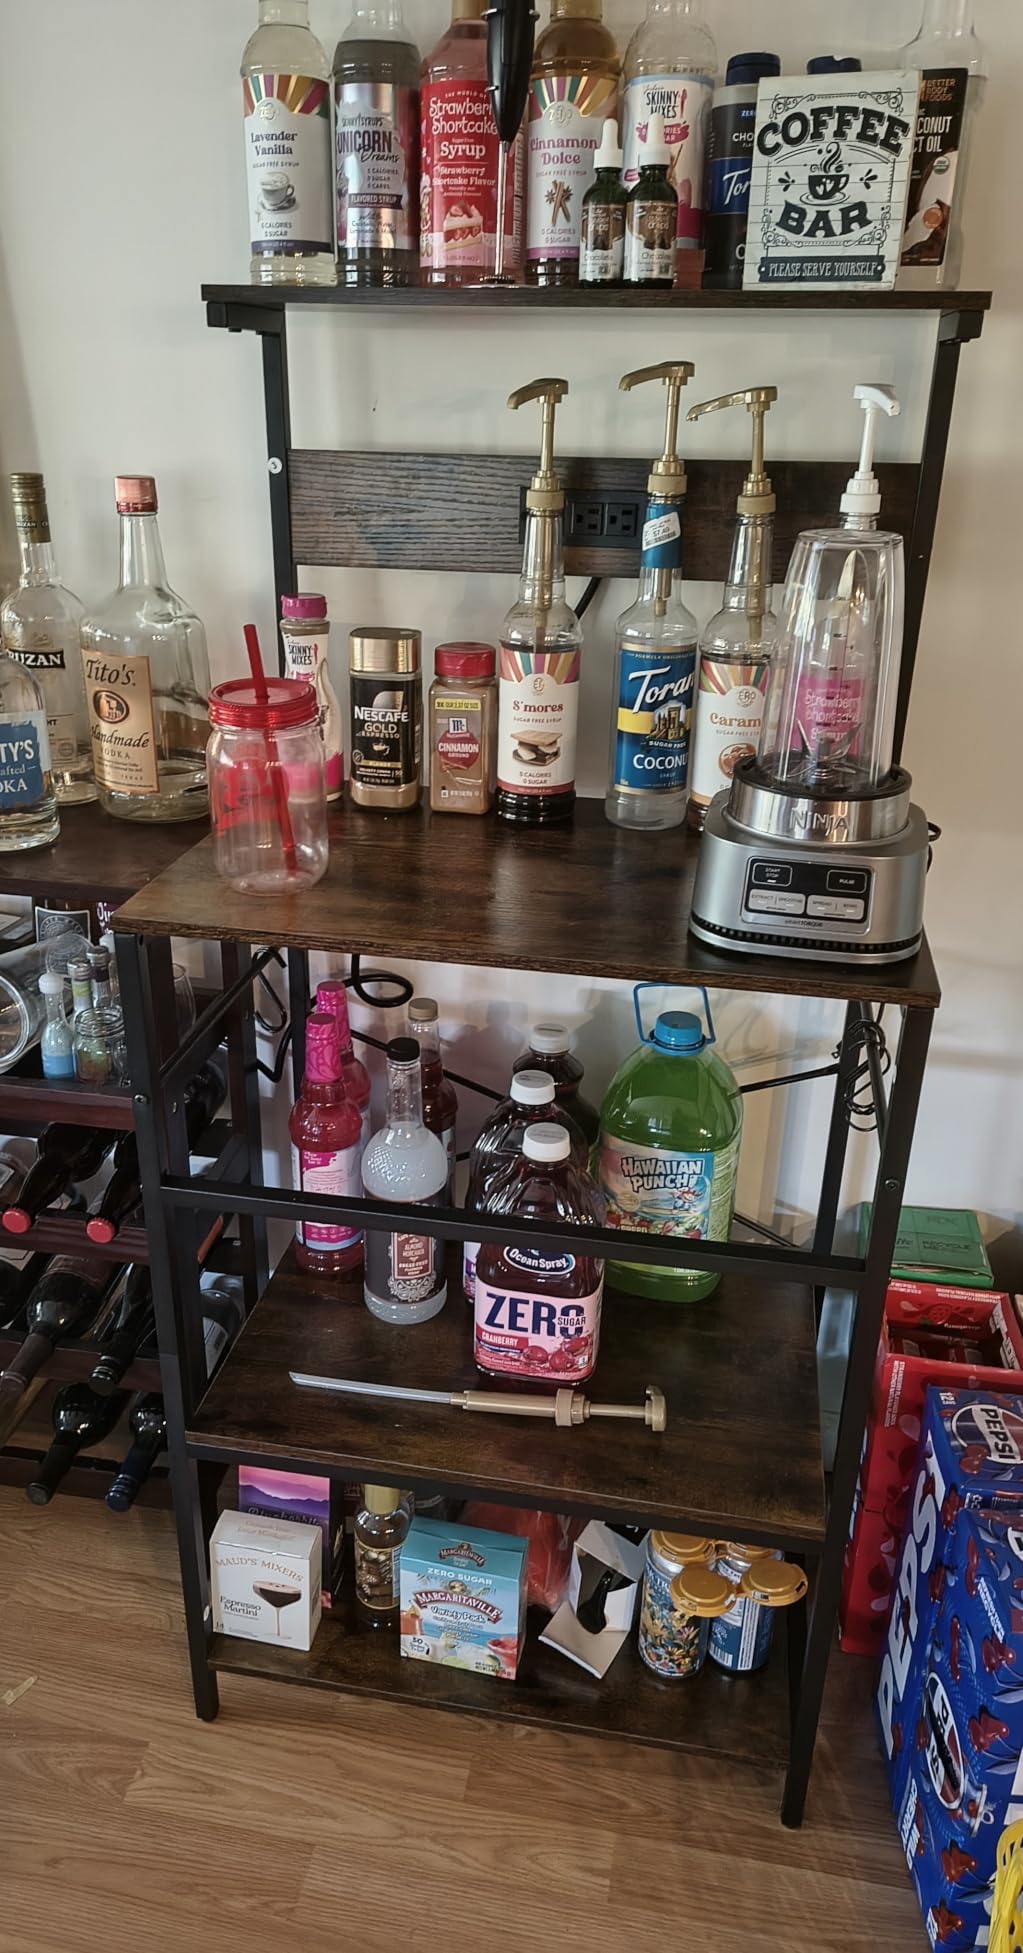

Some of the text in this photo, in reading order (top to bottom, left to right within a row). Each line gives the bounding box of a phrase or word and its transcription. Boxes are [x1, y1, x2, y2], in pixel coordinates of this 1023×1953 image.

[646, 91, 679, 105] SKINNY
[429, 97, 492, 117] Strawberr
[432, 116, 498, 135] Shortcake
[757, 105, 911, 157] COFFEE
[917, 115, 953, 134] CONUT
[251, 130, 298, 143] Lavender
[337, 130, 393, 153] UNICORN
[529, 137, 598, 151] Cinnamon
[732, 132, 753, 142] CHO
[926, 135, 943, 152] OIL
[255, 144, 293, 156] Vanilla
[360, 145, 400, 162] Dreams
[441, 141, 486, 159] Syrup
[541, 152, 582, 165] Dolce
[439, 166, 486, 176] Strawberry
[469, 177, 496, 185] Flavor
[722, 167, 752, 206] Tor
[775, 200, 873, 238] BAR
[769, 261, 878, 277] PLEASE SERVE YOURSELF
[7, 650, 62, 667] RUZAN
[628, 664, 695, 715] Toran
[512, 700, 564, 712] S'mores
[364, 722, 398, 734] GOLD
[710, 712, 761, 727] Caram
[92, 723, 150, 749] Handmade
[361, 731, 400, 739] ESPRESSO
[0, 739, 35, 763] TY'S
[438, 742, 480, 753] CINNAMON
[648, 740, 673, 749] SUGAR
[632, 752, 688, 770] COCONU
[0, 764, 27, 776] afted
[789, 808, 849, 836] NINJA
[621, 1157, 703, 1176] HAWAIIAN
[630, 1174, 691, 1194] PUNCH
[539, 1257, 568, 1270] Spray
[484, 1291, 586, 1339] ZERO SUGAR
[481, 1330, 519, 1347] CRANBERRY
[981, 1407, 1017, 1460] PEPSI
[215, 1556, 304, 1582] MAUD'S MIXERS
[427, 1567, 493, 1585] ZERO SUGAR
[220, 1595, 262, 1612] Espresso
[878, 1430, 946, 1760] PEPSI
[223, 1603, 258, 1617] Martini
[414, 1591, 502, 1620] MARGARITAVILLE
[430, 1605, 486, 1624] Variety Pack
